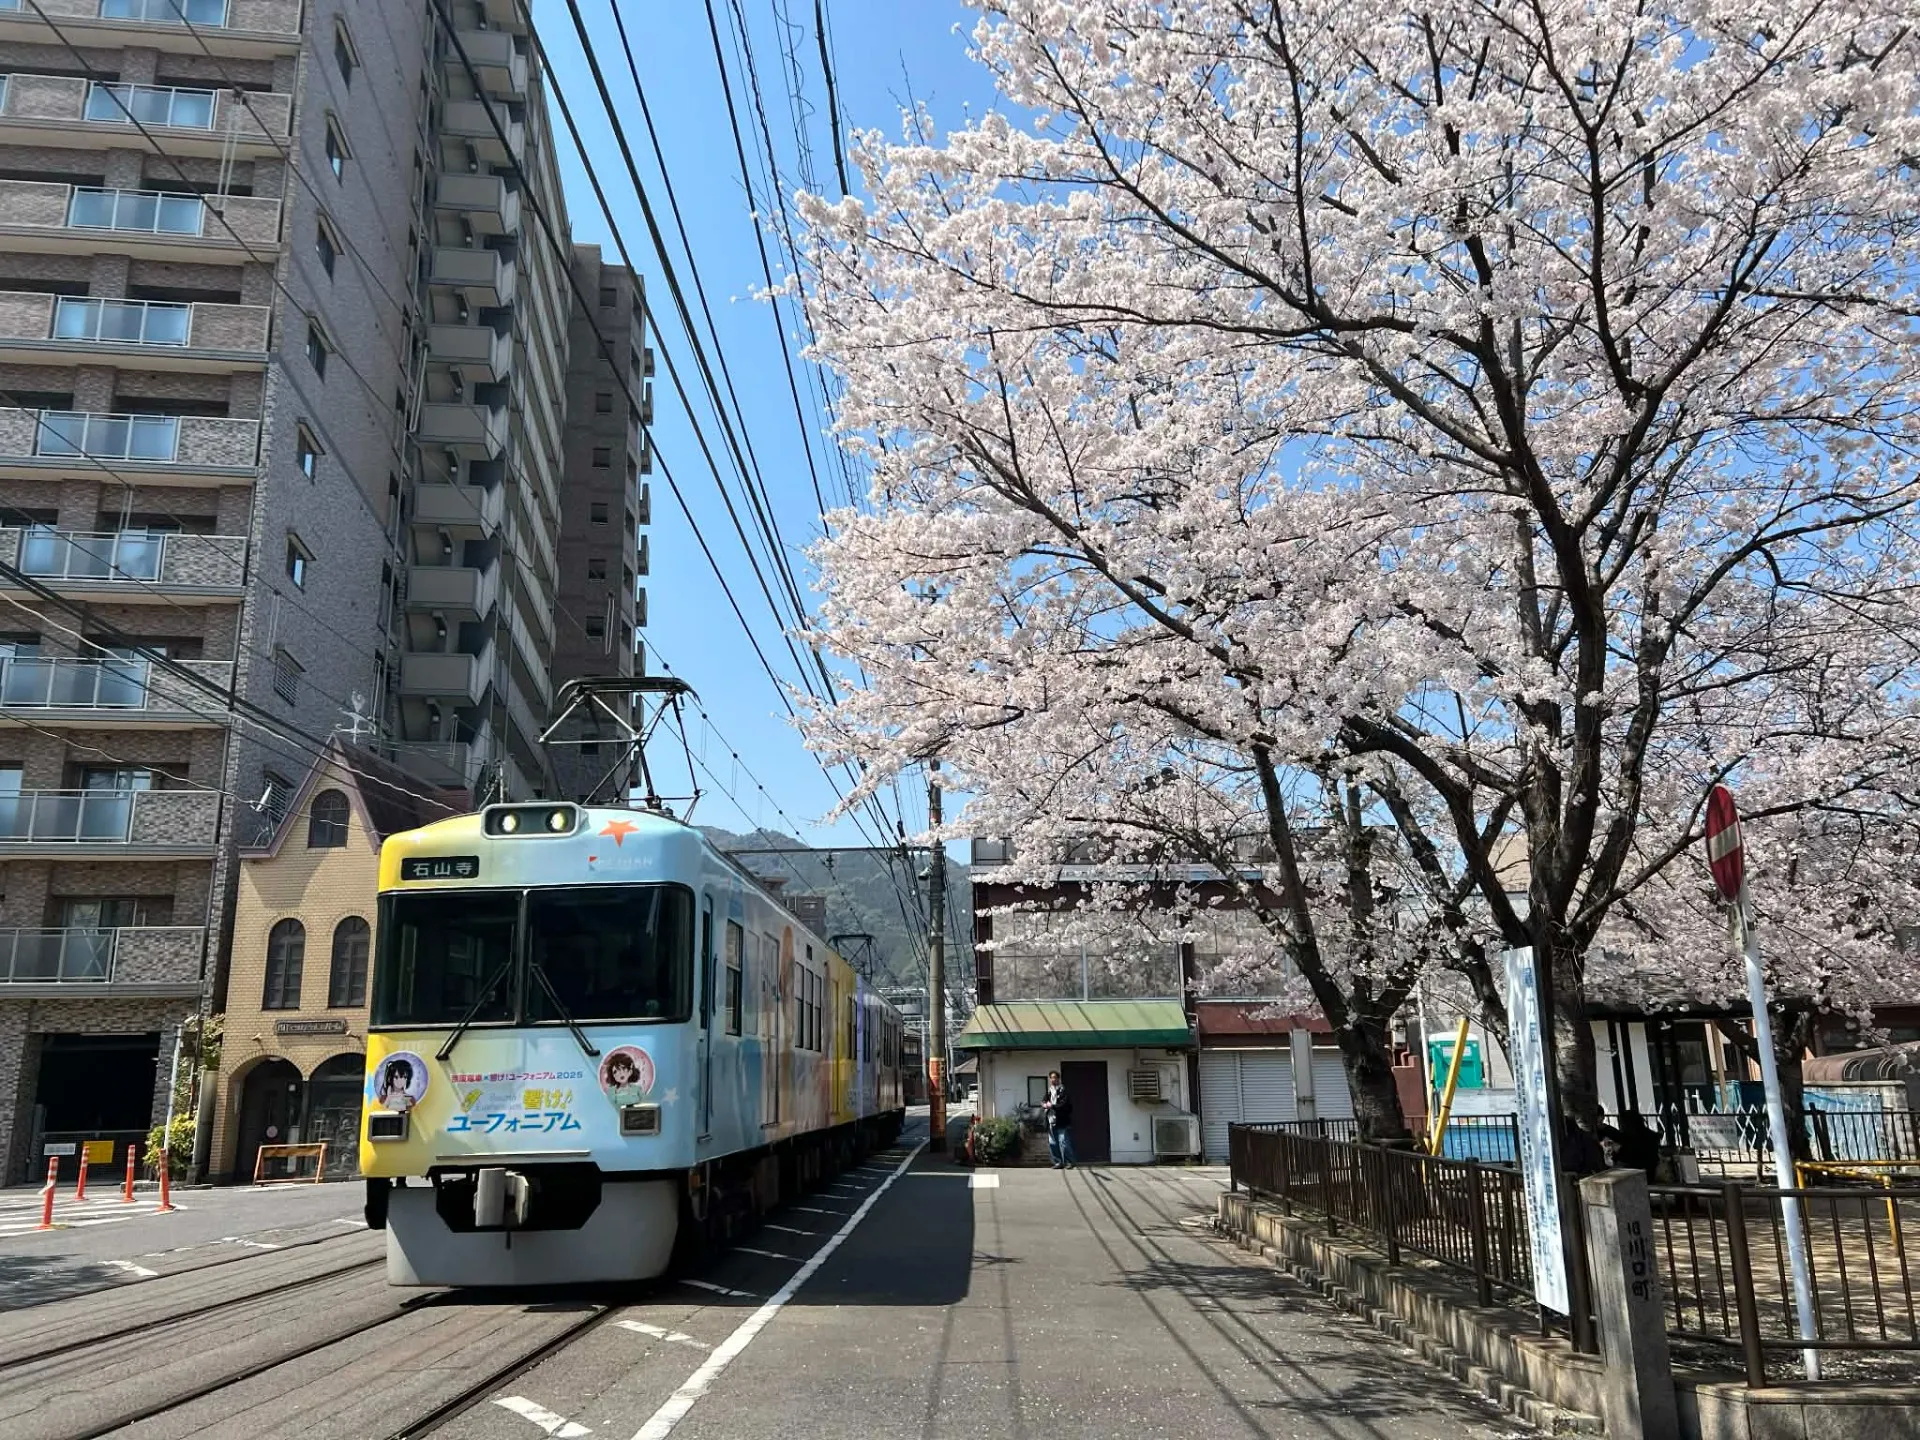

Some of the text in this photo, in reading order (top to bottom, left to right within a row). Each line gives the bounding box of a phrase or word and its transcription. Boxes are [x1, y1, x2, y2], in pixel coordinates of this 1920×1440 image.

[412, 862, 473, 876] 石山寺
[447, 1112, 582, 1133] ユーフォニアム
[1627, 1220, 1649, 1301] 旧川口町
